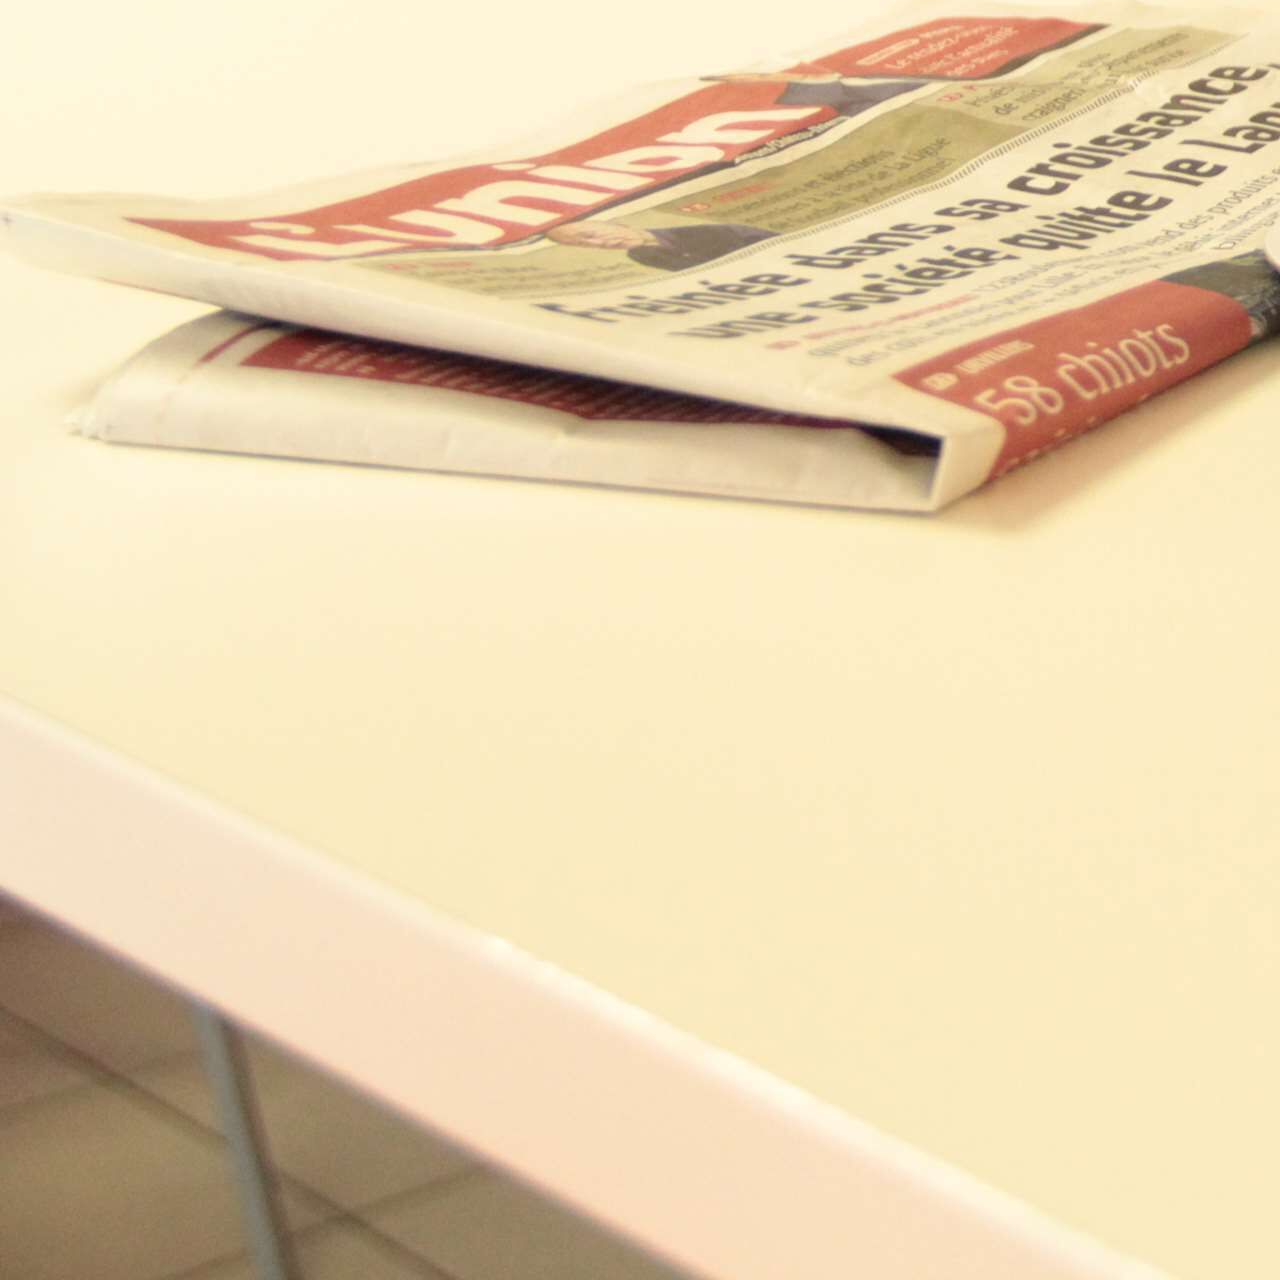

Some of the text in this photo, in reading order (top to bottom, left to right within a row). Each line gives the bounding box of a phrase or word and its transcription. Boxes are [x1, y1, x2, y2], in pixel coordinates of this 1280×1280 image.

[534, 272, 812, 323] Freinée
[784, 223, 956, 269] dans
[934, 198, 1030, 221] sa
[667, 310, 821, 339] une
[800, 243, 1021, 312] société
[998, 189, 1174, 251] quitte
[1125, 157, 1228, 187] le
[973, 375, 1065, 427] 58
[1057, 322, 1192, 402] chiots
